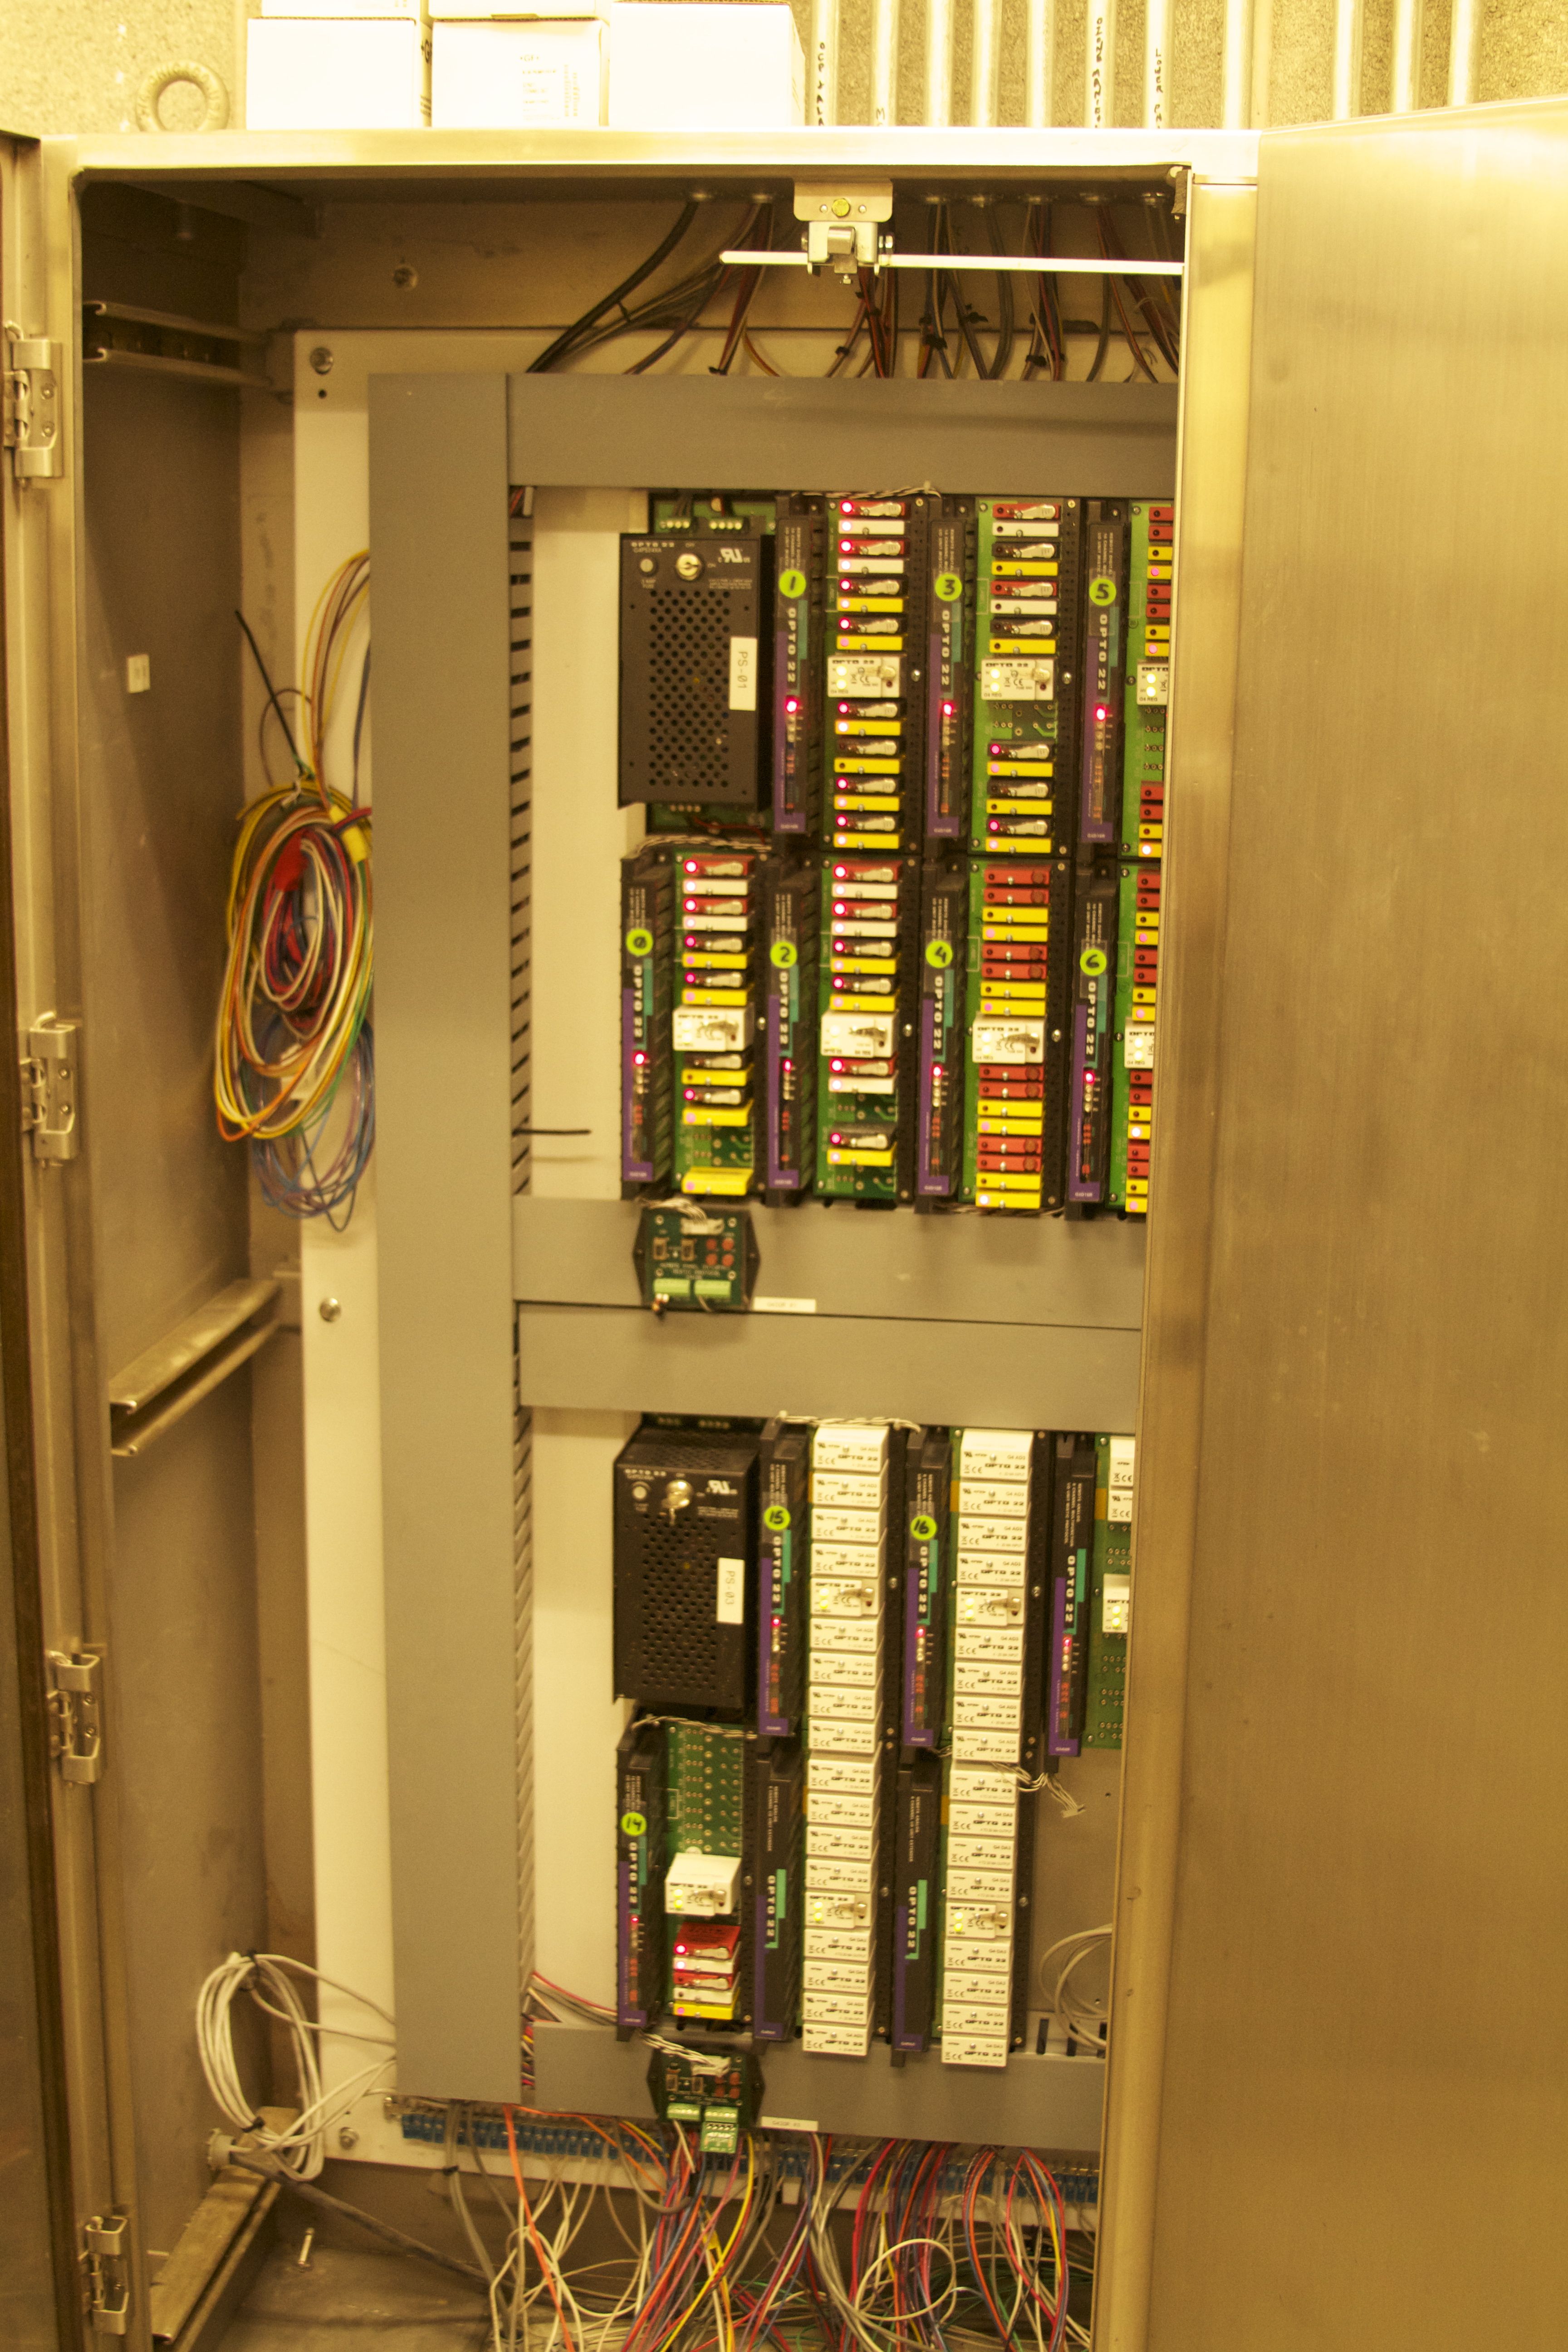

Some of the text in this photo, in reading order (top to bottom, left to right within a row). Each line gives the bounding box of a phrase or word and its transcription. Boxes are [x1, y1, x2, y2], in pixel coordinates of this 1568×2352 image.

[943, 579, 956, 595] 3
[1096, 583, 1109, 599] 5
[737, 652, 748, 688] PS-01
[787, 608, 797, 683] OPTO 22
[941, 664, 950, 686] 22
[1098, 614, 1108, 690] OPTO 22
[781, 946, 790, 962] 2
[935, 946, 947, 964] 4
[1086, 954, 1099, 968] 6
[633, 965, 642, 1038] OPTO 22
[779, 971, 789, 1044] OPTO 22
[934, 976, 943, 1049] OPTO 22
[1086, 981, 1096, 1054] OPTO 22
[769, 1510, 784, 1524] 15
[914, 1519, 929, 1534] 16
[725, 1571, 735, 1605] PS-03
[773, 1536, 781, 1602] OPTO 22
[919, 1546, 928, 1612] OPTO 22
[1065, 1555, 1076, 1622] OPTO 22
[627, 1817, 642, 1831] 14
[628, 1842, 637, 1904] OPTO 22
[767, 1875, 775, 1937] OPTO 22
[908, 1886, 916, 1948] OPTO 22
